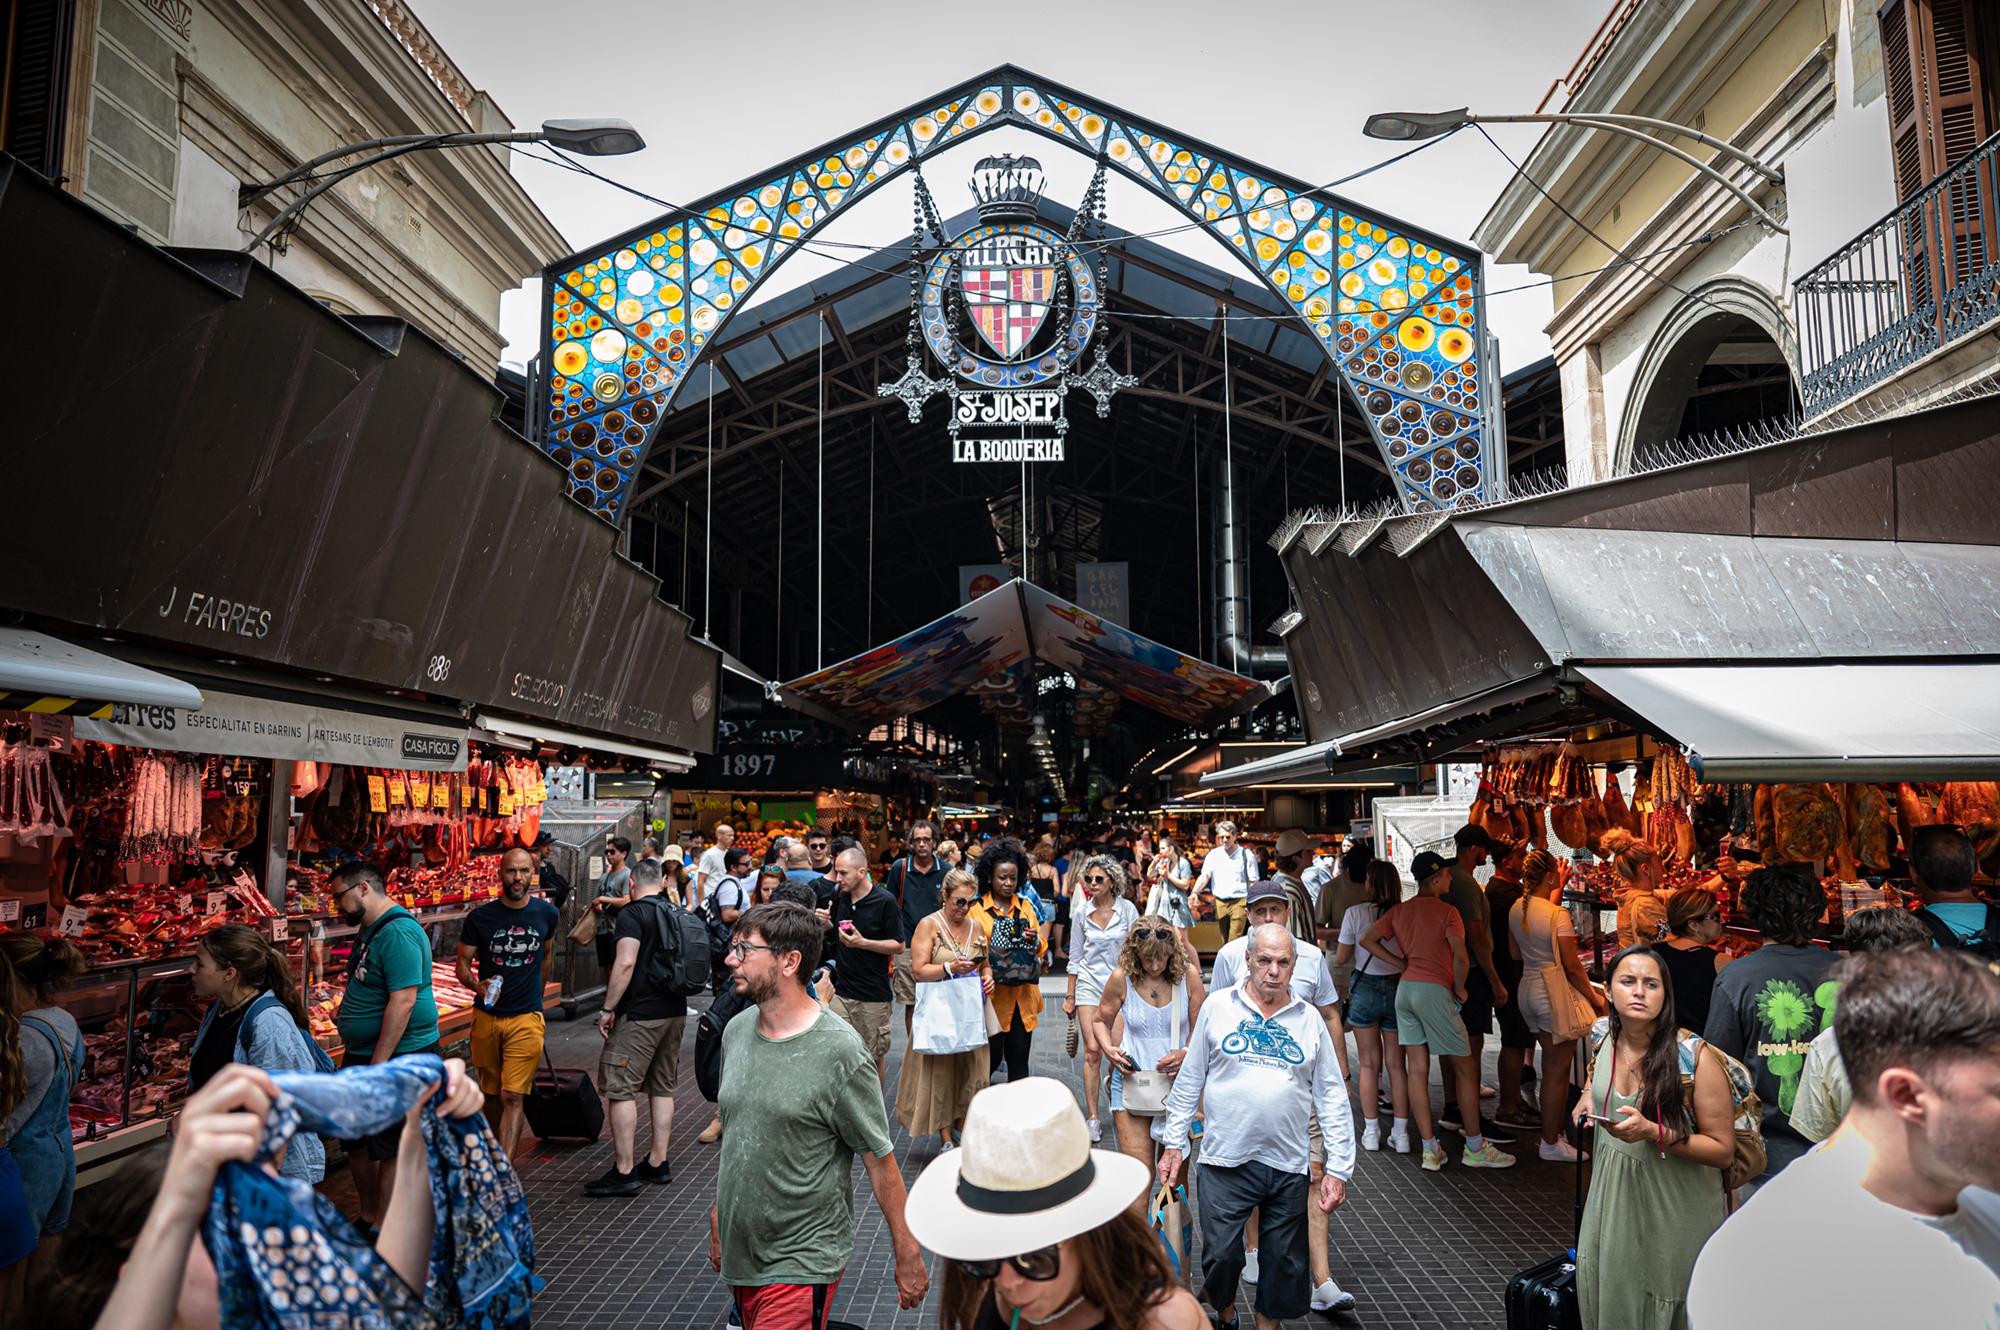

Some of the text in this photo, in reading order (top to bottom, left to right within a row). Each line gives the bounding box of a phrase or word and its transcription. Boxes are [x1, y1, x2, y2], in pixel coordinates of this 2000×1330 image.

[981, 393, 1060, 423] JOSEP
[953, 440, 1064, 462] LA BOQUERIA
[159, 586, 271, 639] J FARRES
[427, 655, 451, 682] 888
[187, 714, 302, 738] ESPECIALITAT EN GARRINS
[314, 729, 351, 745] ARTESANS
[353, 733, 362, 746] DE
[721, 754, 776, 776] 1897
[24, 915, 36, 929] 61
